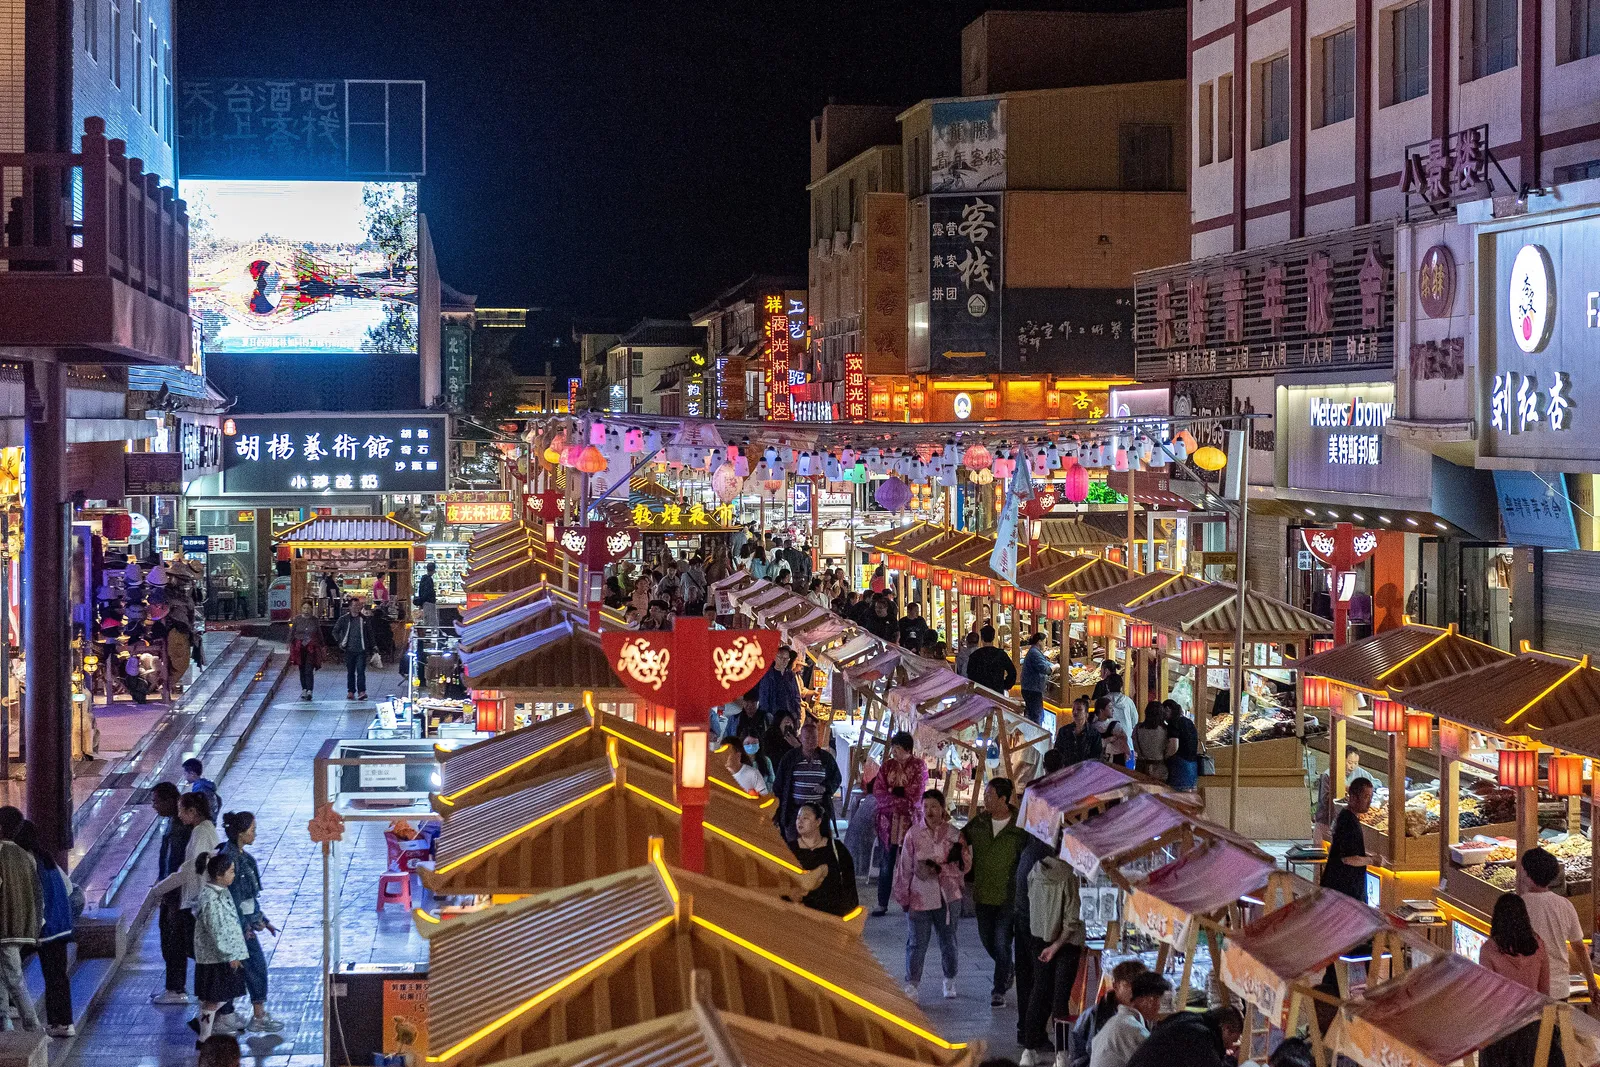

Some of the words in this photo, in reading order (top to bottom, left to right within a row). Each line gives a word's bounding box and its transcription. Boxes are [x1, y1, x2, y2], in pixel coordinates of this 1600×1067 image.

[1399, 128, 1480, 197] 八景楼
[932, 222, 958, 237] 露营
[957, 197, 996, 291] 客栈
[932, 254, 958, 269] 散客
[932, 287, 958, 301] 拼团
[1261, 342, 1287, 369] 六人间
[1303, 337, 1332, 366] 八人间
[773, 318, 789, 416] 夜光杯批发
[848, 357, 864, 417] 欢迎光临
[1492, 371, 1569, 436] 刘红杏
[234, 432, 394, 462] 胡楊藝術館
[400, 444, 430, 455] 奇石
[1328, 434, 1380, 466] 美特斯邦威
[447, 504, 513, 521] 夜光杯批发
[631, 502, 735, 528] 敦煌夜市
